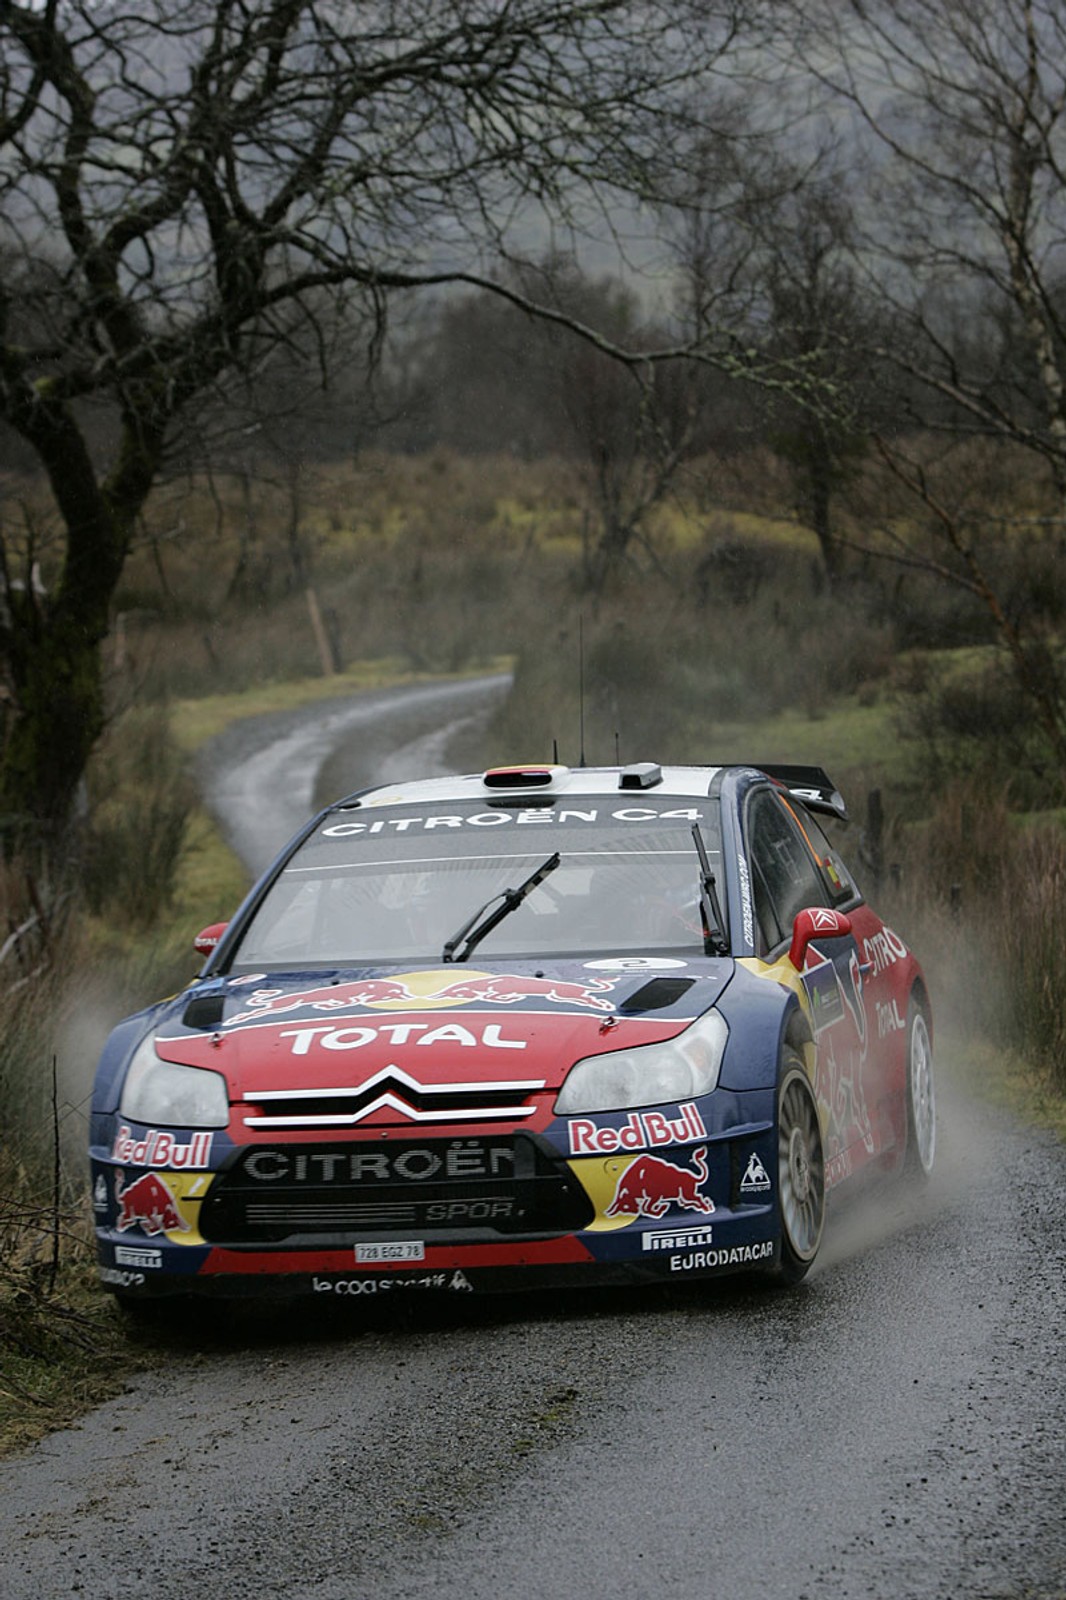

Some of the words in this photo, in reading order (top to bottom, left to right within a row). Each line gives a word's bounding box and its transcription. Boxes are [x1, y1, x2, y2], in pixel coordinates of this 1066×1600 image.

[321, 807, 598, 838] CITROËN
[611, 807, 704, 822] C4
[618, 958, 650, 968] 2
[875, 998, 906, 1039] TOTAL
[279, 1022, 528, 1055] TOTAL
[567, 1112, 643, 1156] Red
[641, 1102, 708, 1147] Bull
[112, 1126, 153, 1164] Red
[151, 1130, 214, 1168] Bull
[426, 1202, 526, 1222] SPOR
[641, 1225, 713, 1251] PIRELLI
[114, 1245, 163, 1269] PIRELLI
[669, 1241, 775, 1272] EURODATACAR
